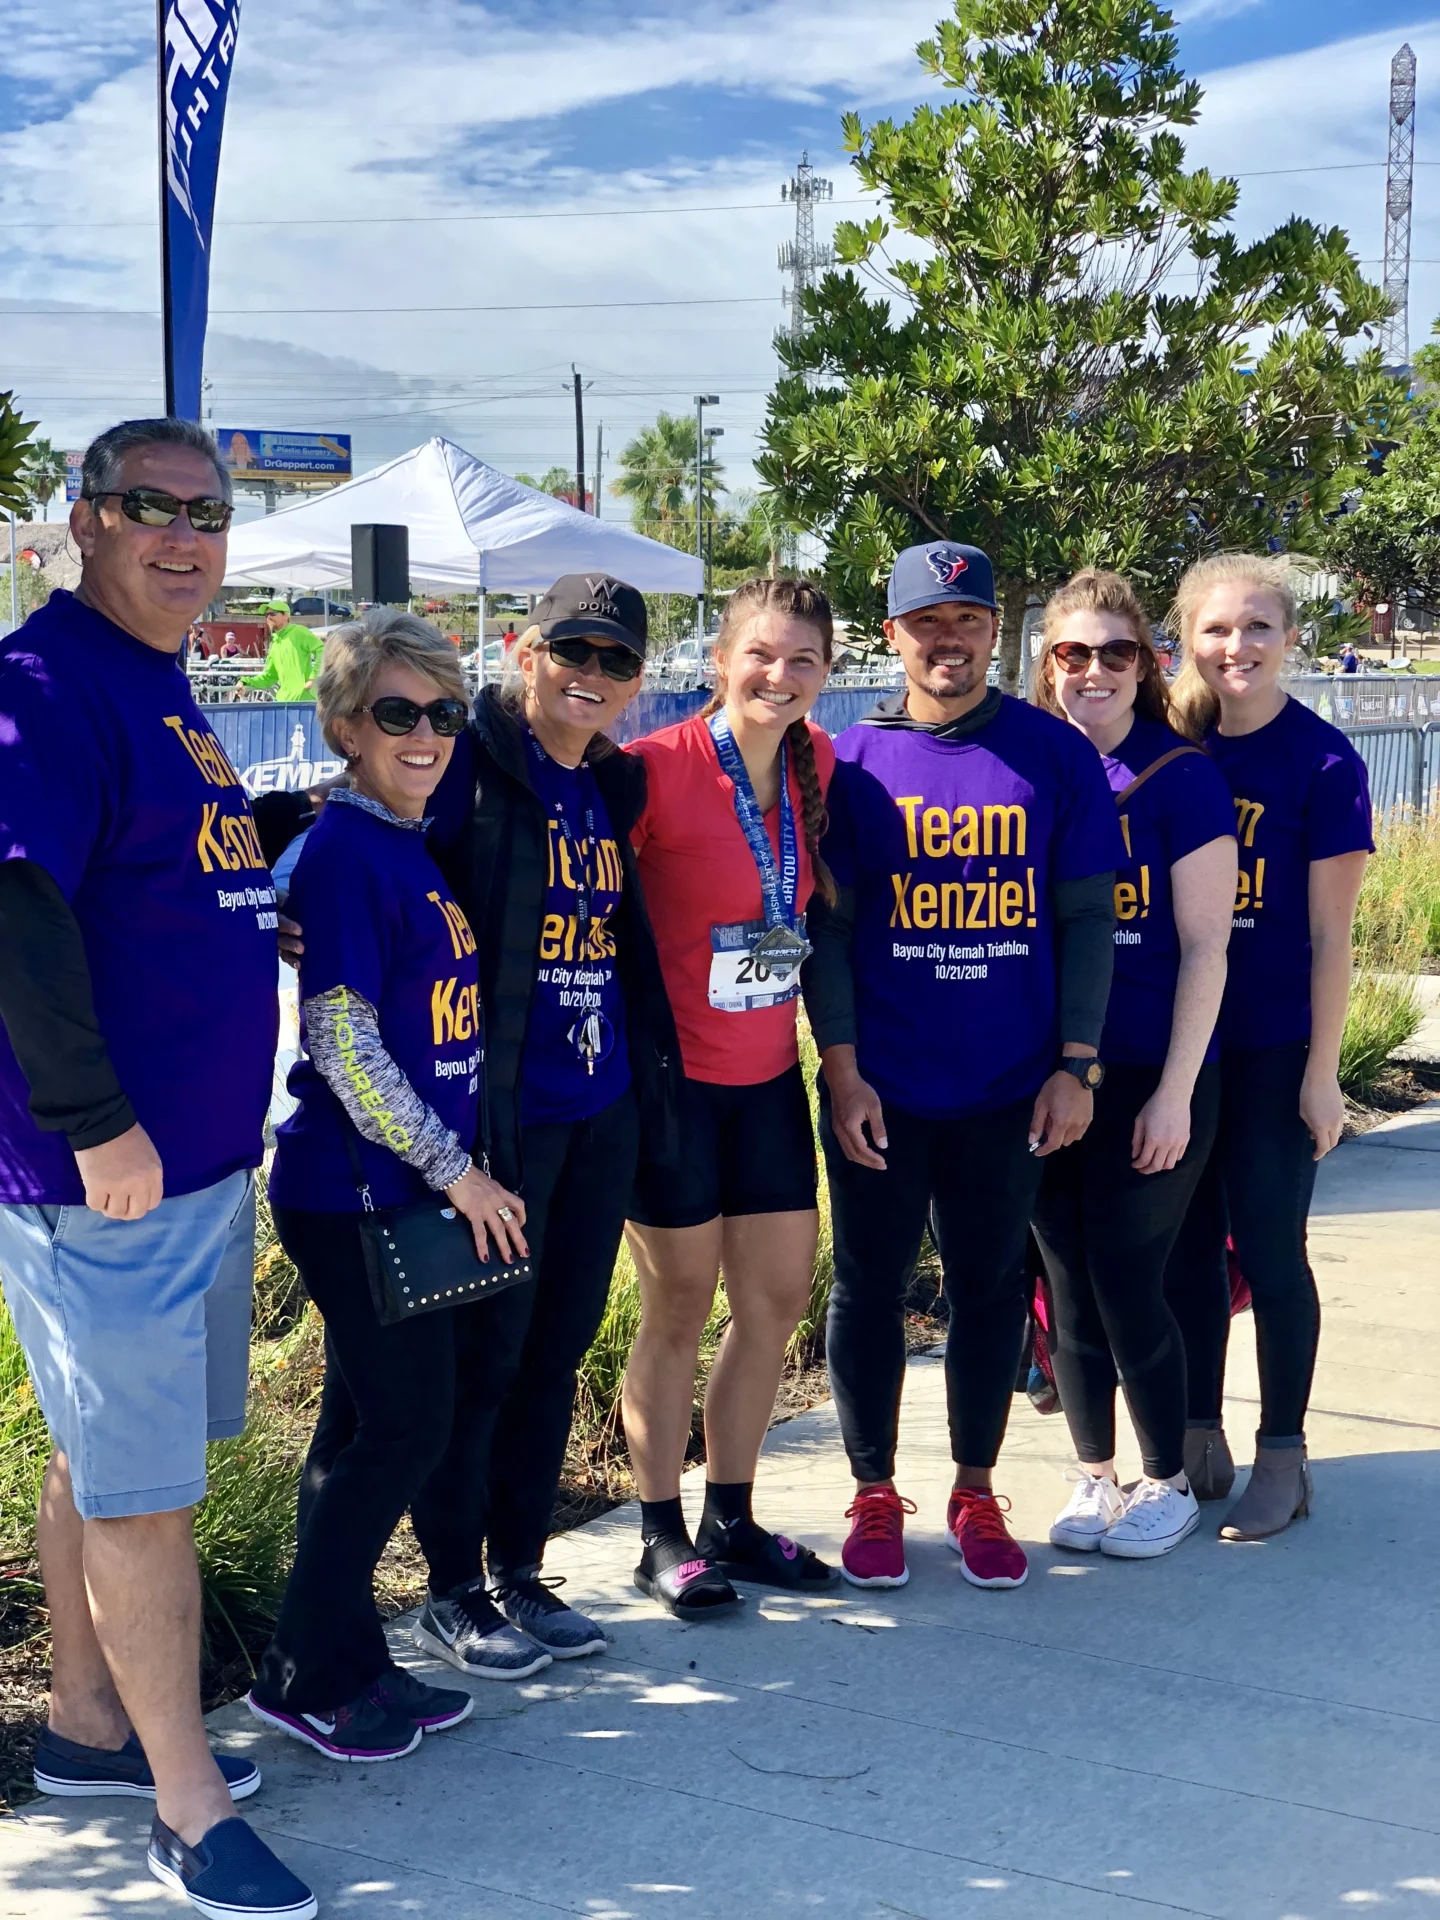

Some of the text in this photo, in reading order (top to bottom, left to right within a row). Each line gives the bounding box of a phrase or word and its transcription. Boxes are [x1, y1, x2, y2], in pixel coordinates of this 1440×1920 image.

[276, 446, 331, 456] Plastic Surgery
[264, 459, 335, 470] DrGeppert.com
[585, 577, 621, 600] W
[578, 601, 620, 617] DOHA
[895, 795, 1027, 859] Team
[758, 850, 774, 881] ADULT
[217, 889, 246, 912] Bayou
[892, 940, 1029, 962] Bayou City Kemah Triathlon
[551, 967, 573, 988] City
[934, 964, 988, 980] 10/21/2018
[434, 1060, 467, 1080] Bayou
[678, 1559, 707, 1576] NIKE
